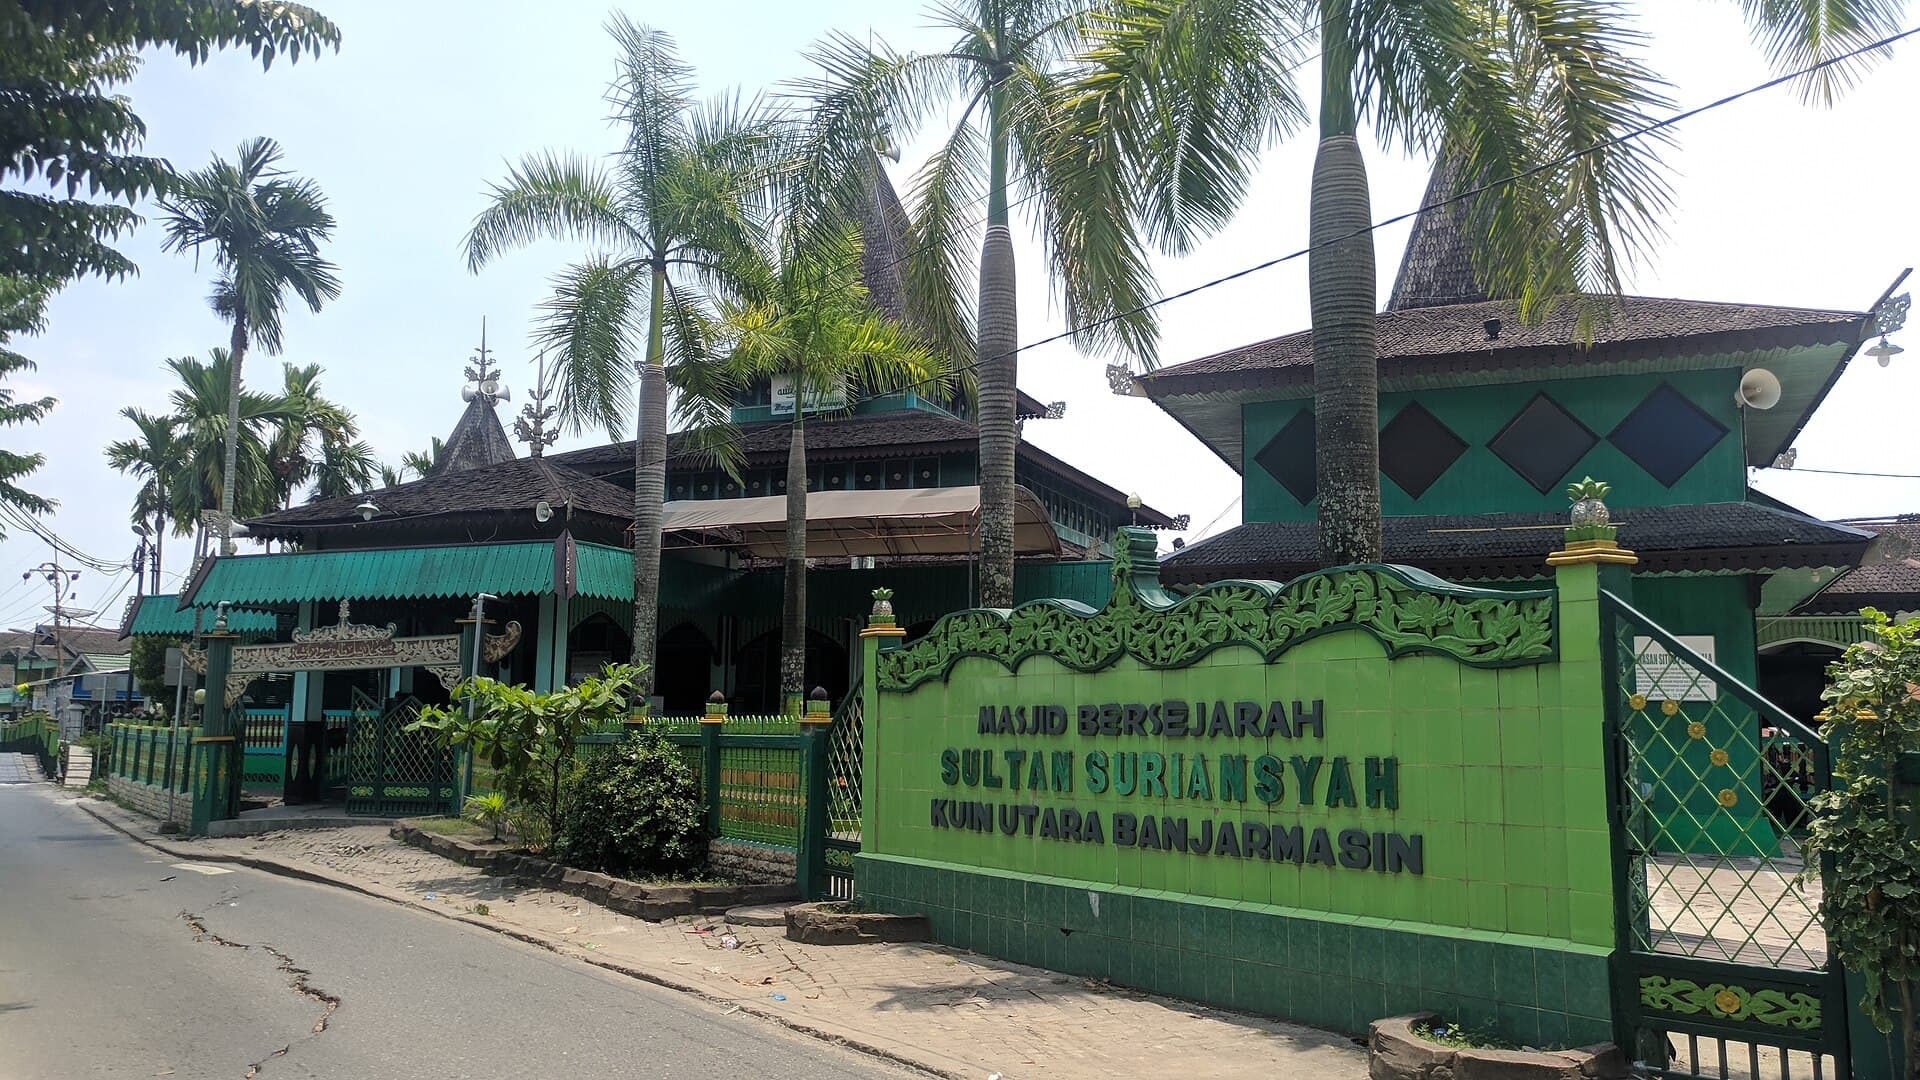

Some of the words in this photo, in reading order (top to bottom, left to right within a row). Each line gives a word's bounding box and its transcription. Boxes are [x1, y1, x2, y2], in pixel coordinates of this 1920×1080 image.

[977, 705, 1068, 735] MASJID
[1077, 700, 1324, 738] BERSEJARAH
[941, 748, 1073, 792] SULTAN
[1085, 750, 1398, 809] SURIANSYAH
[930, 798, 993, 833] KUIN
[998, 803, 1104, 844] UTARA
[1112, 812, 1423, 875] BANJARMASIN
